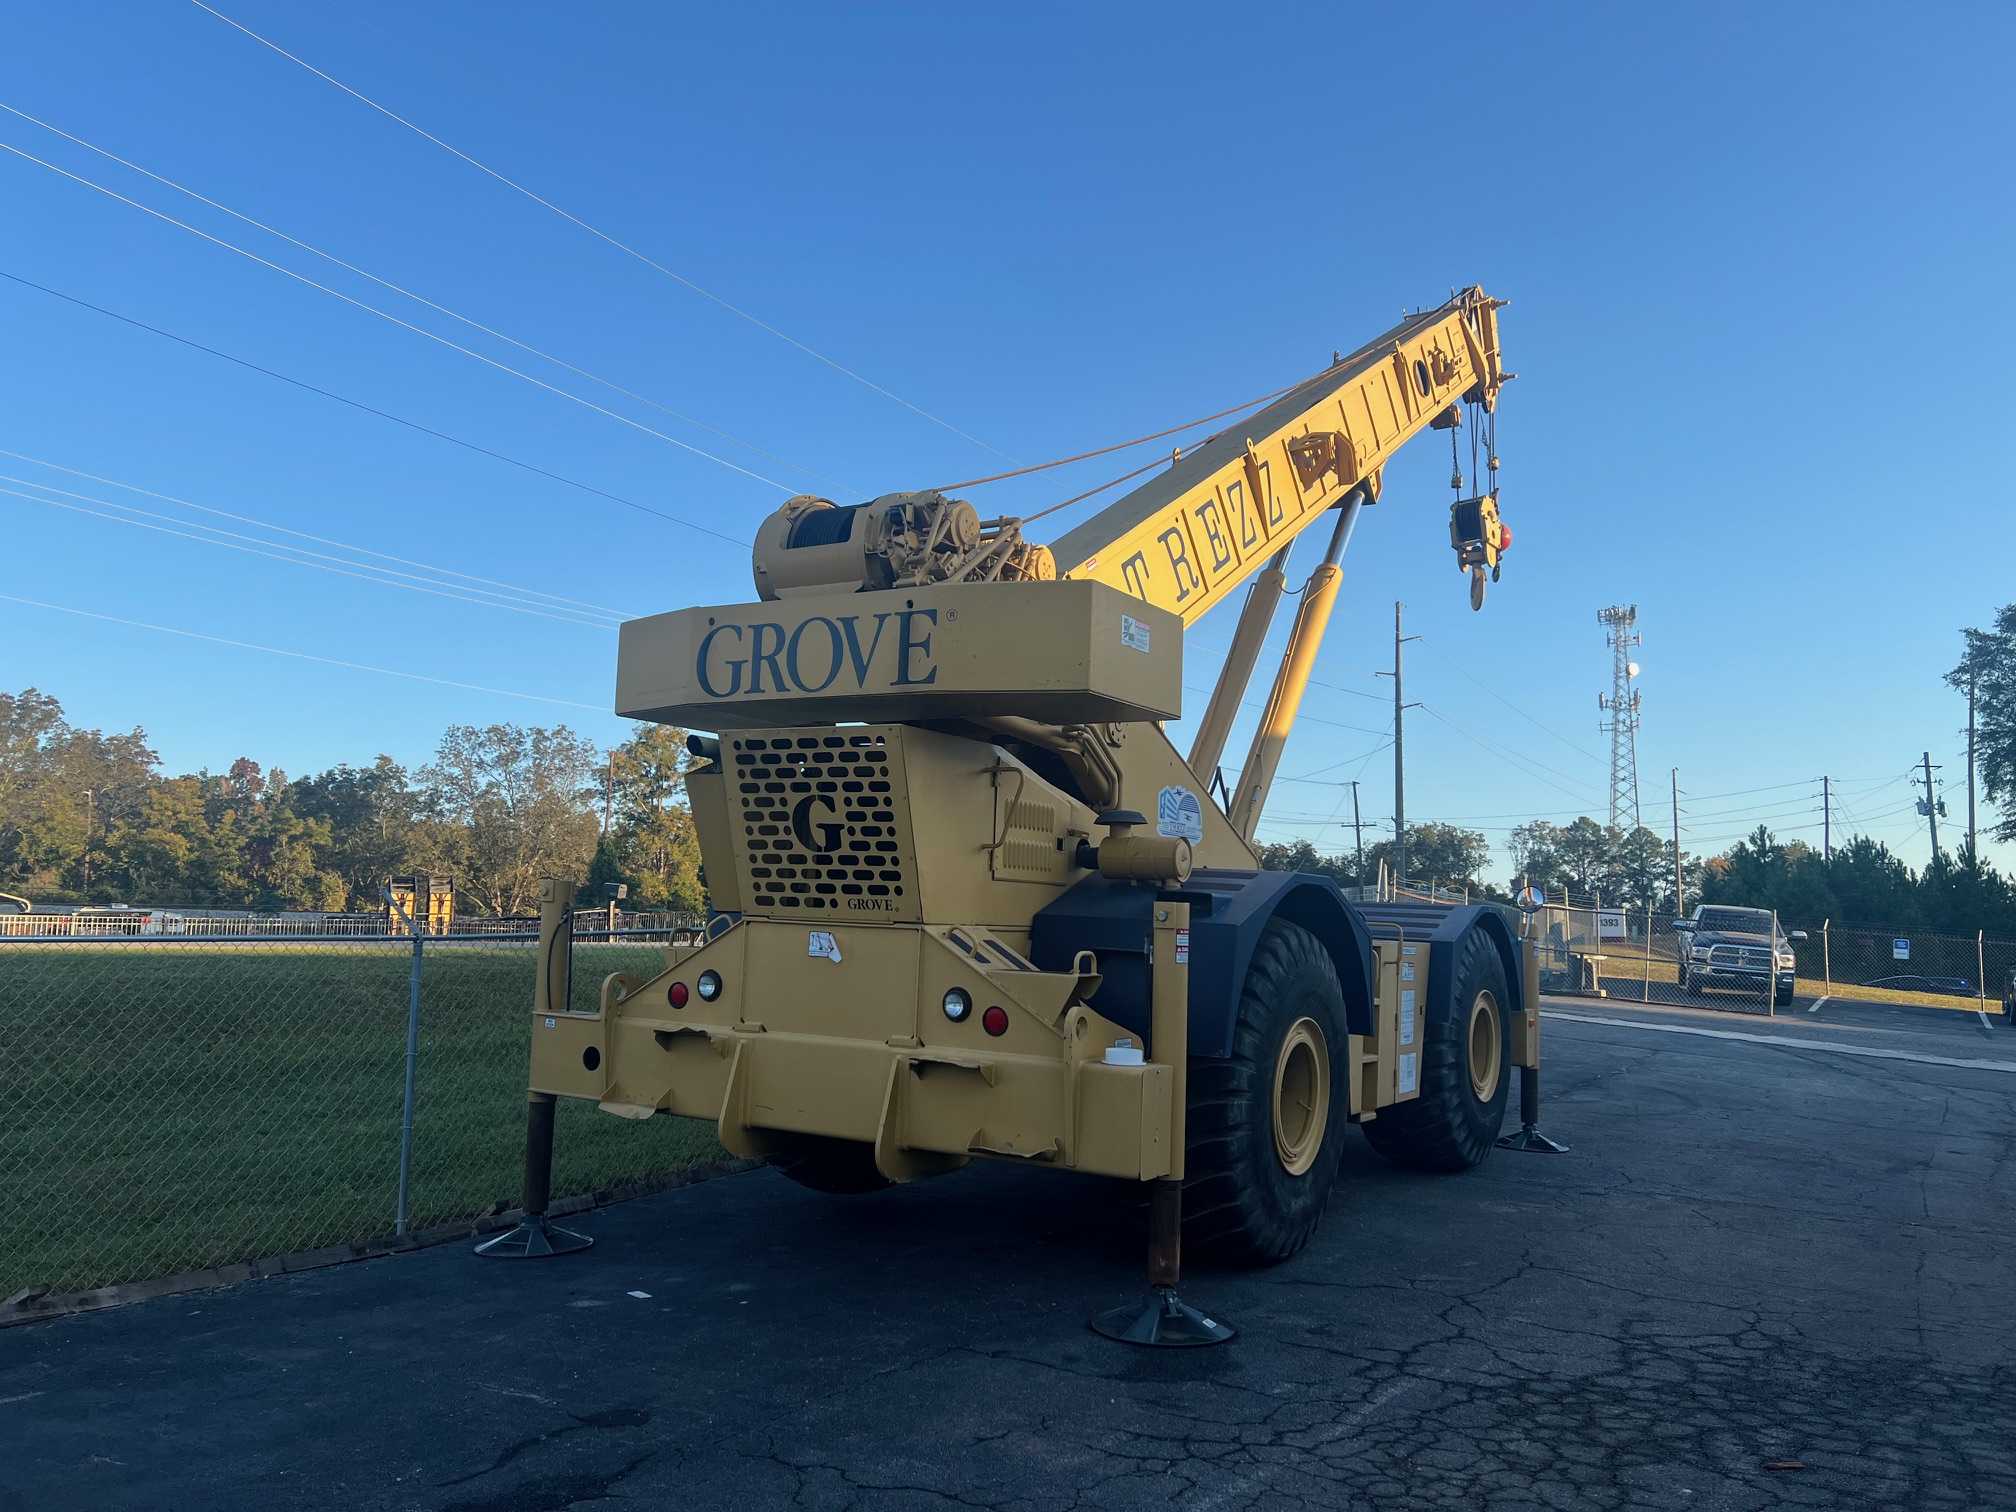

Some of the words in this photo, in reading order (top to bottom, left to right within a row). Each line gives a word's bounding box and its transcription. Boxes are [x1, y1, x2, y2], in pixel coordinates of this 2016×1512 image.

[696, 608, 938, 698] GROVE
[792, 794, 845, 853] G
[847, 898, 893, 911] GROVE
